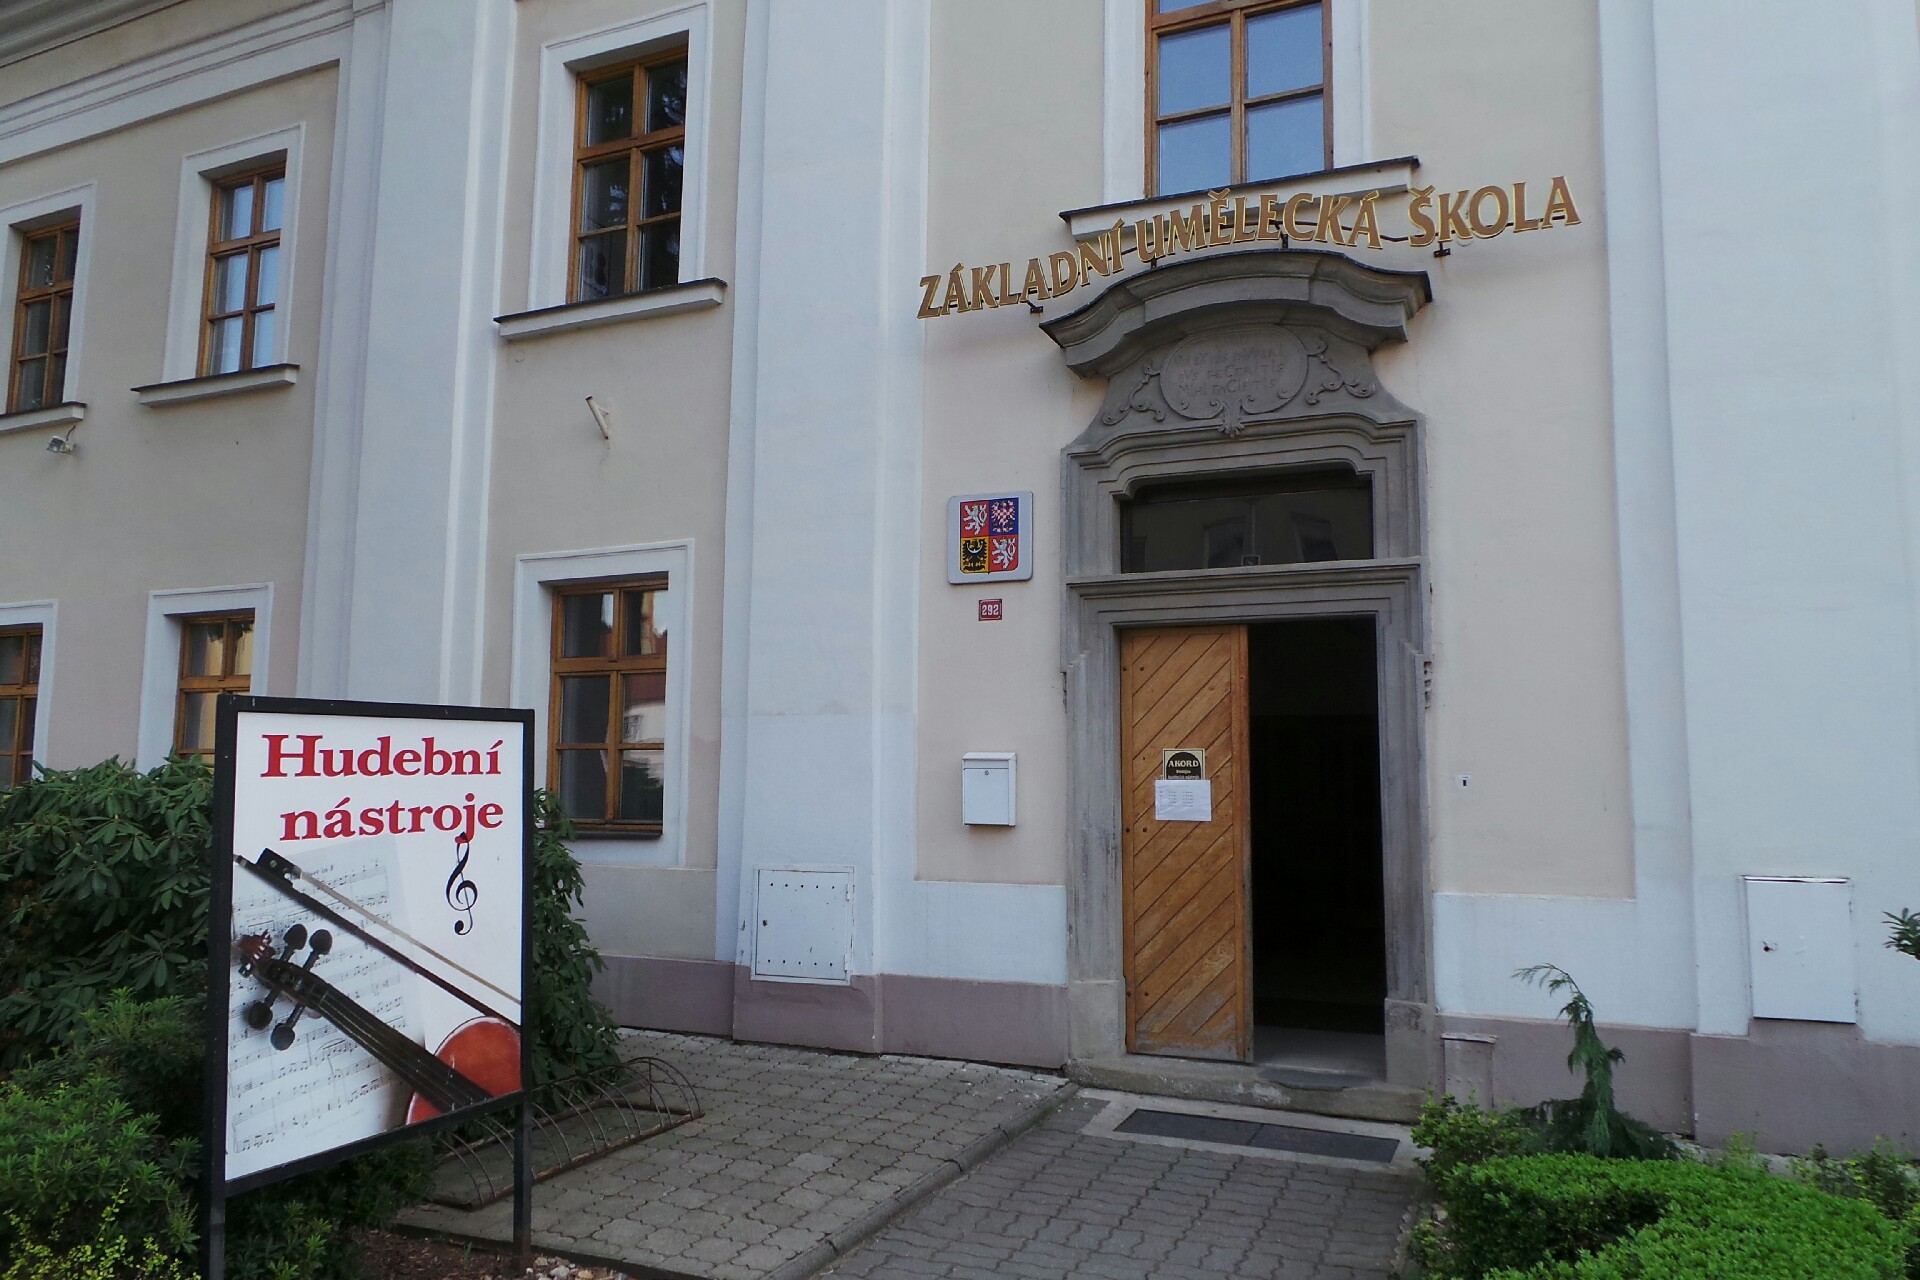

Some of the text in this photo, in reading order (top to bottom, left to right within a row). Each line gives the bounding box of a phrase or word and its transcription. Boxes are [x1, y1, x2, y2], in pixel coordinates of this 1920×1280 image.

[917, 175, 1582, 319] ZÁKLADNÍ UMĚLECKÁ ŠKOLA
[981, 604, 999, 616] 292
[260, 734, 504, 778] Hudební
[1168, 760, 1199, 768] AKORD
[279, 792, 504, 844] nástroje
